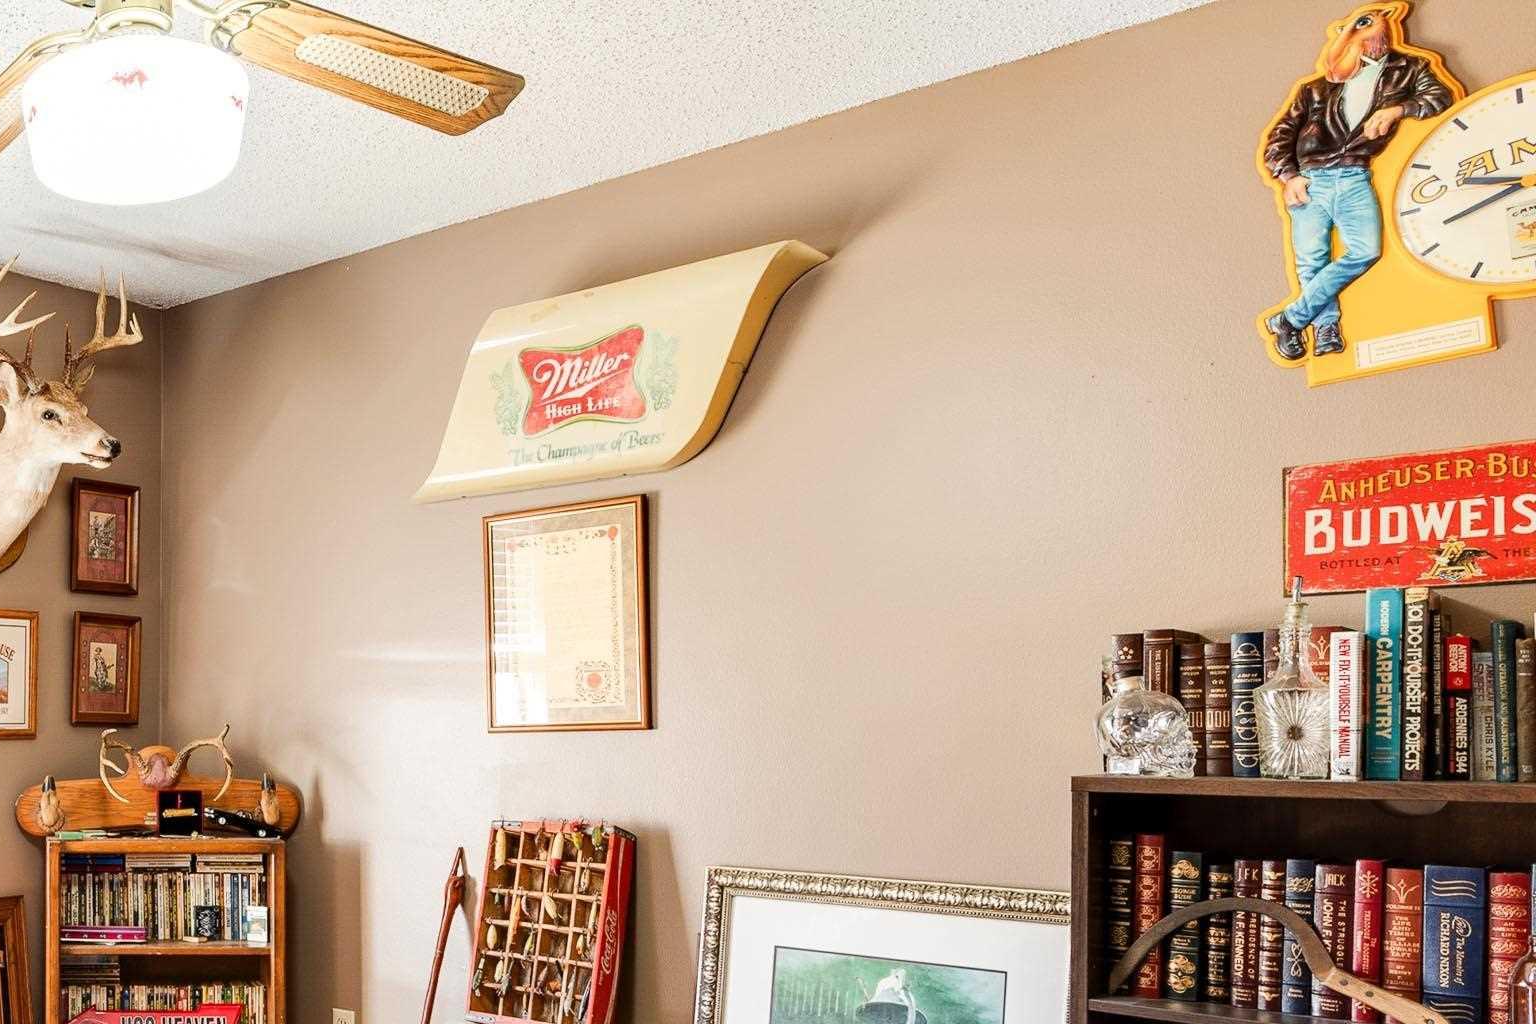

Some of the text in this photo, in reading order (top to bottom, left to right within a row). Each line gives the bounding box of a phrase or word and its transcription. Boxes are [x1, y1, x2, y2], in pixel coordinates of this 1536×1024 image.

[534, 352, 634, 400] Miller
[545, 397, 622, 420] HIGH LIFE
[510, 448, 533, 466] The
[536, 441, 608, 465] Champagne
[610, 433, 625, 453] of
[1319, 556, 1401, 570] BOTTLED AT
[1502, 548, 1531, 558] THE
[1375, 600, 1393, 739] MODERN CARPENTRY
[1406, 626, 1424, 713] DO-IT-YOURSELF
[1448, 643, 1458, 673] BEEVOR
[1457, 643, 1467, 673] ANTONY
[1338, 639, 1351, 758] NEW FIX-IT-YOURSELF MANUAL
[1404, 717, 1422, 771] PROJECTS
[1455, 697, 1467, 773] ARDENNES 1944
[1484, 715, 1493, 772] CHRIS KYLE
[1237, 868, 1259, 882] JFK
[1324, 873, 1346, 888] JACK
[1323, 898, 1333, 928] JOHN
[1338, 900, 1347, 914] THE
[602, 909, 618, 975] Coca-Cola
[1233, 930, 1246, 978] KENNEDY
[1439, 912, 1451, 988] RICHARD NIXON
[1456, 937, 1464, 949] The
[1247, 968, 1256, 979] OF
[1454, 977, 1465, 986] of
